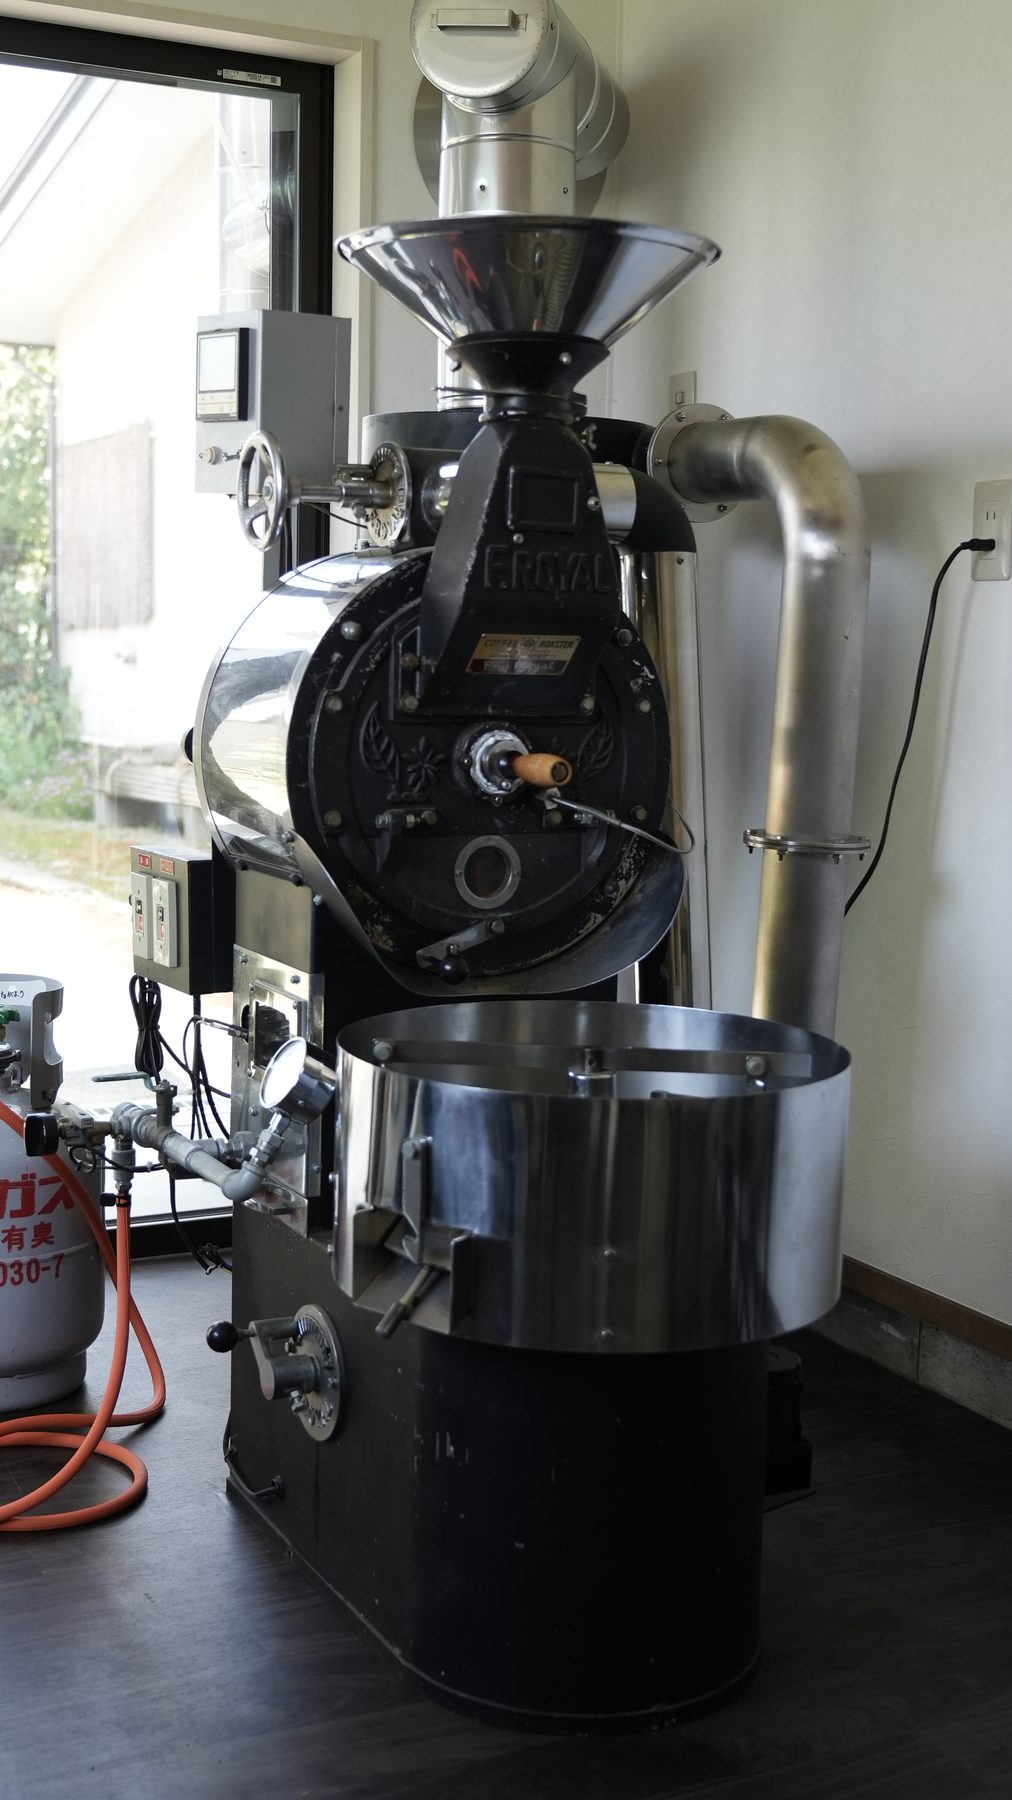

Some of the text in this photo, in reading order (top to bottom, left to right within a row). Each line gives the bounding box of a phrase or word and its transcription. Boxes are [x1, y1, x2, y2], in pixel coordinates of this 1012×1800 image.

[538, 639, 575, 649] ROASTER
[0, 1172, 75, 1220] ガス
[1, 1221, 56, 1253] 有臭
